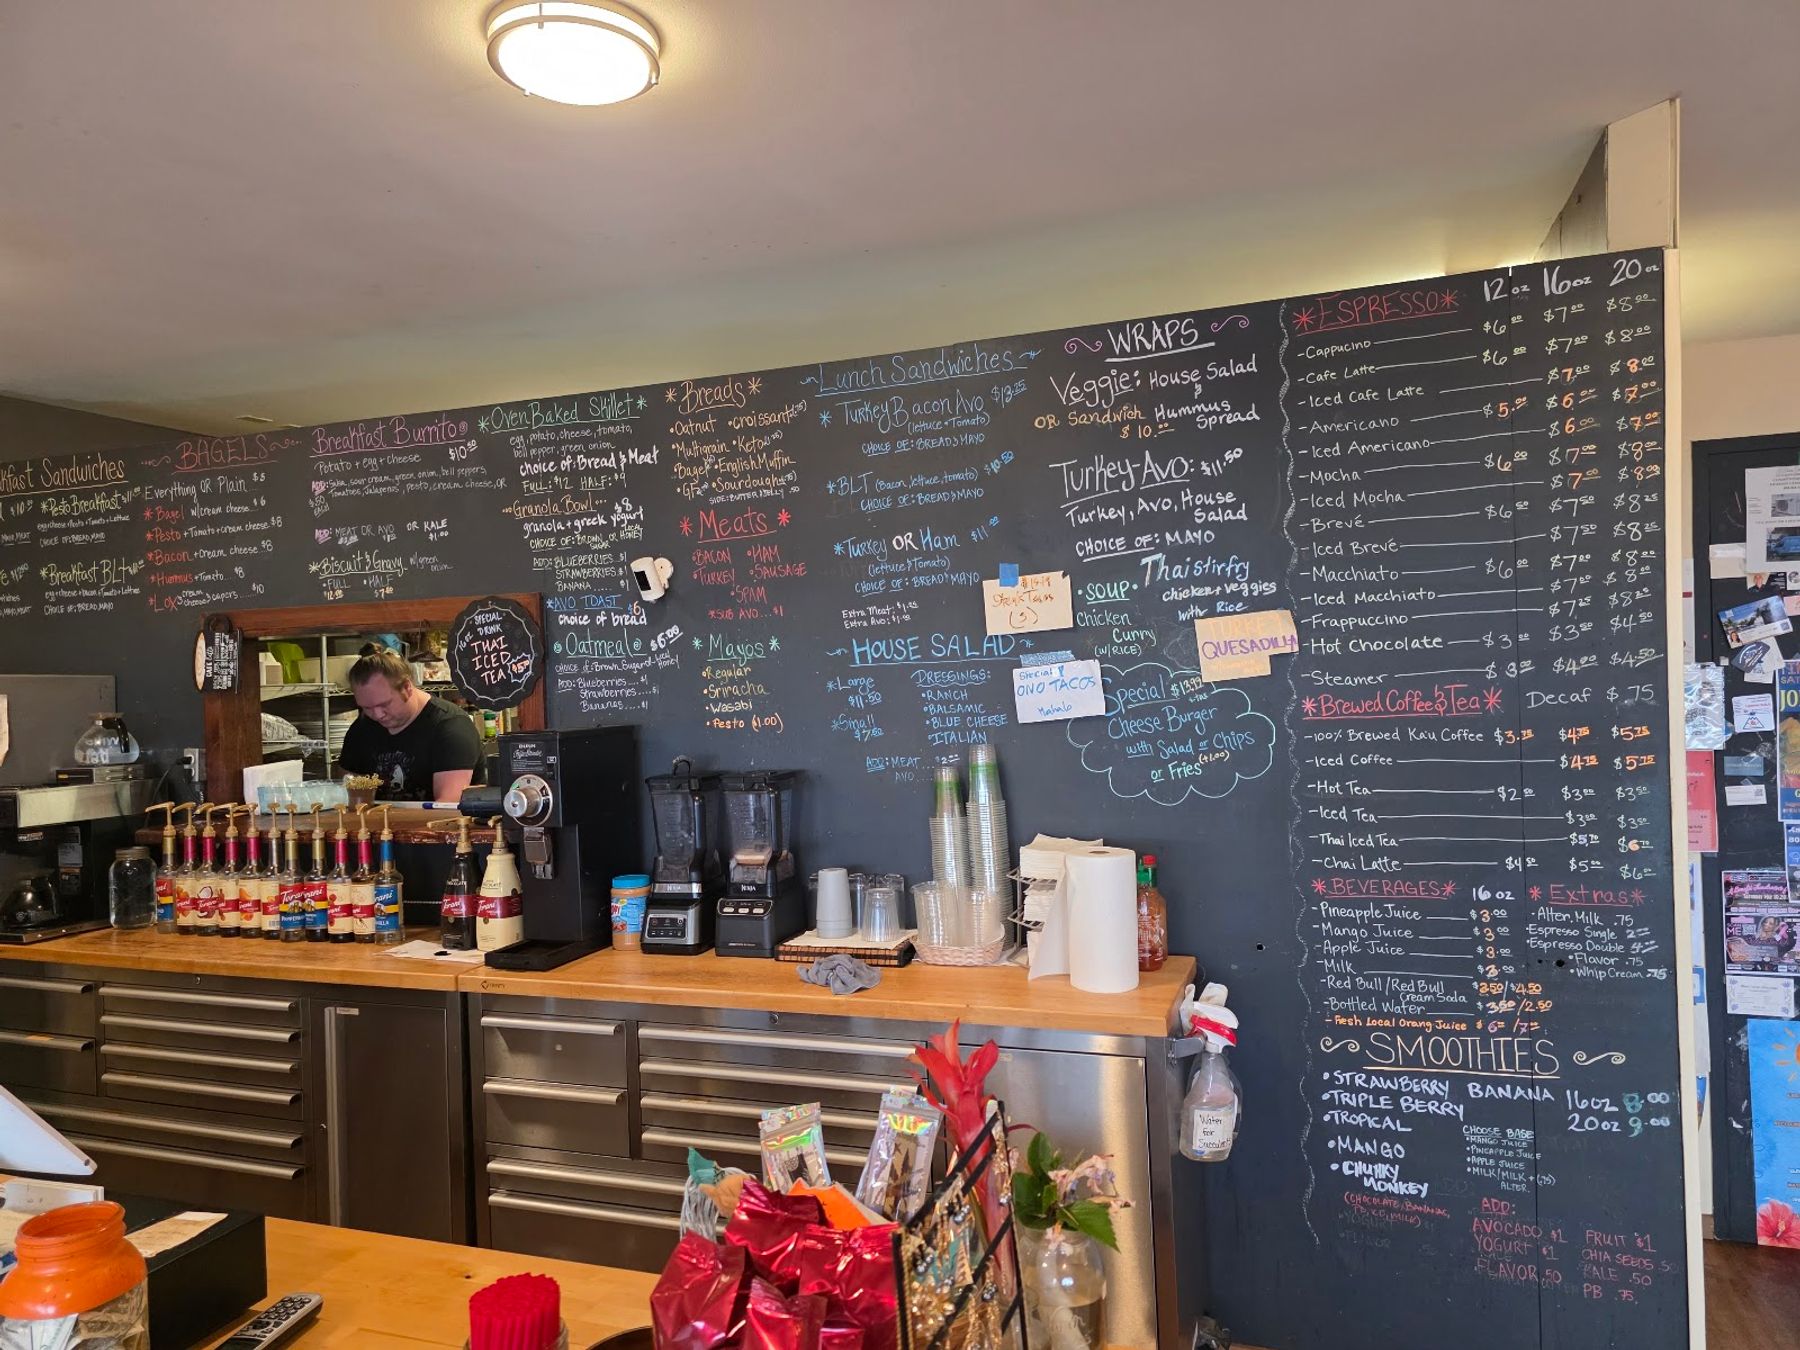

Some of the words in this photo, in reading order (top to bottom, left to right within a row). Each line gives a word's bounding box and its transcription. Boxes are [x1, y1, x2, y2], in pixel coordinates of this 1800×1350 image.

[1107, 319, 1199, 355] WRAPS
[891, 344, 1014, 383] Sandwiches
[1149, 368, 1200, 390] House
[1207, 353, 1258, 380] Salad
[1155, 399, 1230, 421] Hummus
[1196, 403, 1260, 430] Spread
[312, 422, 387, 453] Breakfast
[389, 413, 456, 444] Burrito
[1309, 417, 1399, 434] Americano
[176, 434, 268, 470] BAGELS
[1310, 470, 1361, 484] Mocha
[1181, 489, 1236, 506] House
[1352, 492, 1405, 506] Mocha
[699, 506, 767, 538] Meats
[1194, 504, 1247, 523] Salad
[1076, 537, 1127, 557] CHOICE
[1165, 530, 1215, 546] MAYO
[471, 636, 508, 654] THAI
[853, 636, 921, 664] HOUSE
[1349, 636, 1444, 652] Chocolate
[472, 652, 510, 670] ICED
[481, 669, 506, 685] TEA
[1526, 688, 1592, 709] Decaf
[1162, 706, 1217, 735] Burger
[1350, 755, 1393, 766] Coffee
[1549, 885, 1628, 904] Extras
[1324, 961, 1356, 974] Milk
[1365, 1032, 1559, 1075] SMOOTHIES
[1334, 1071, 1449, 1095] STRAWBERRY
[1468, 1083, 1555, 1101] BANANA
[1400, 1094, 1464, 1121] BERRY
[1338, 1137, 1406, 1158] MANGO
